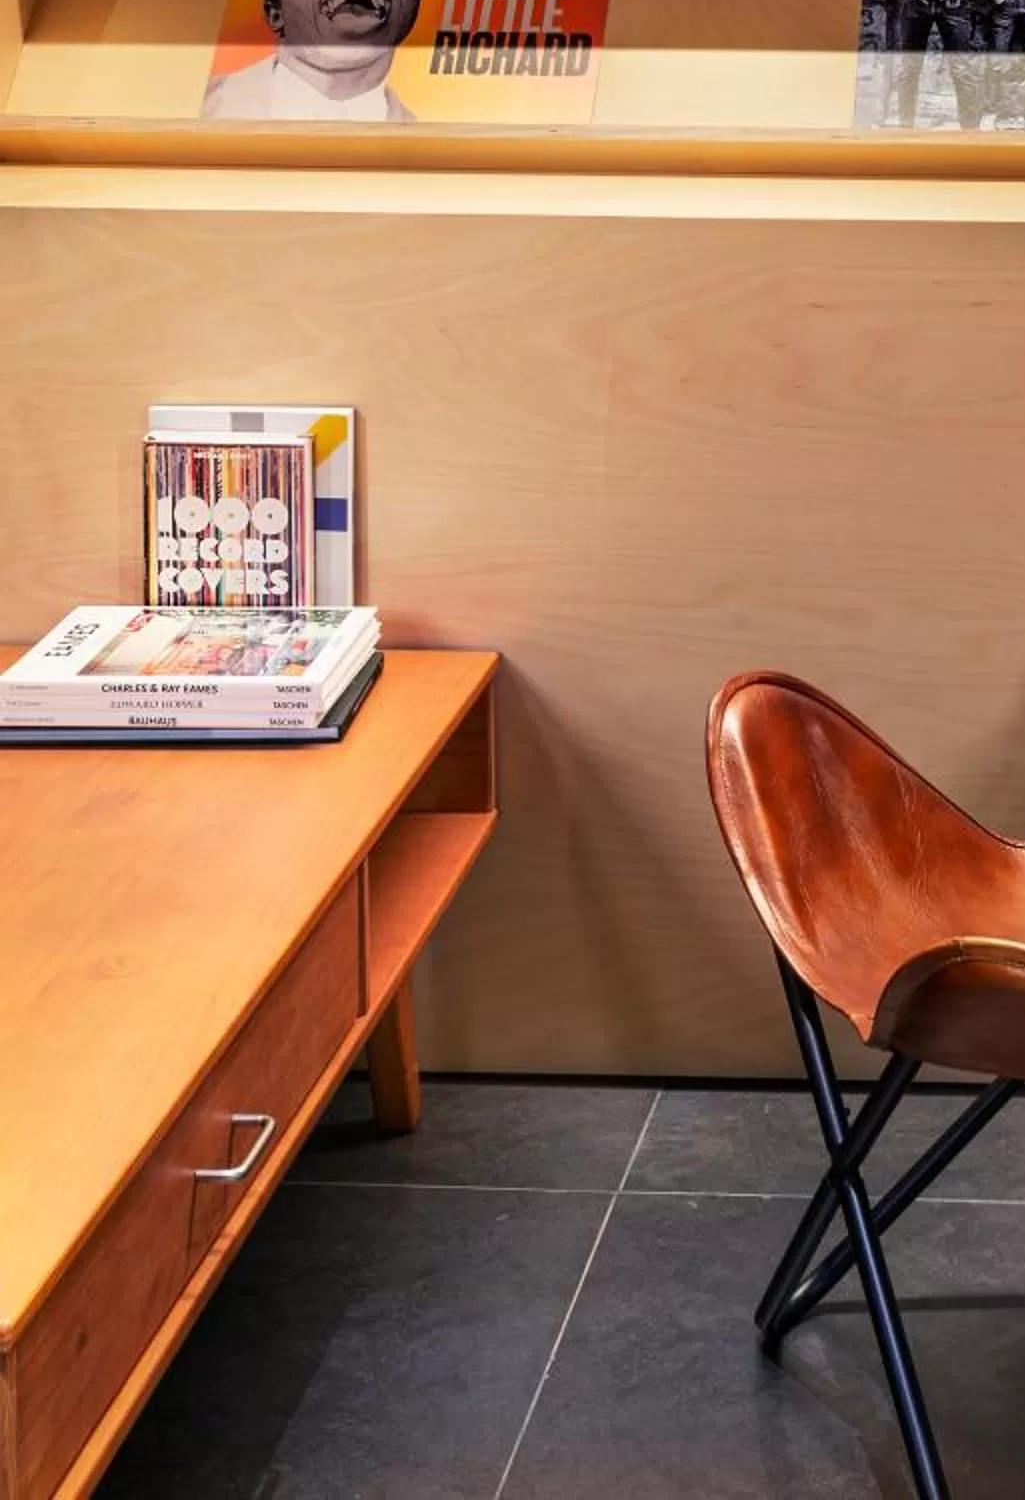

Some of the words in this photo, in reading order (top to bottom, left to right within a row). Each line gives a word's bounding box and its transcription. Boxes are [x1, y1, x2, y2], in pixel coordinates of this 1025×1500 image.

[429, 31, 593, 77] RICHARD
[157, 496, 289, 534] 1000
[158, 537, 289, 563] RECORD
[158, 567, 289, 595] COVERS
[101, 684, 147, 694] CHARLES
[150, 684, 158, 694] &
[161, 684, 181, 694] RAY
[183, 684, 219, 695] EAMES
[276, 685, 311, 693] TASCHEN
[128, 716, 177, 726] BAUHAUS
